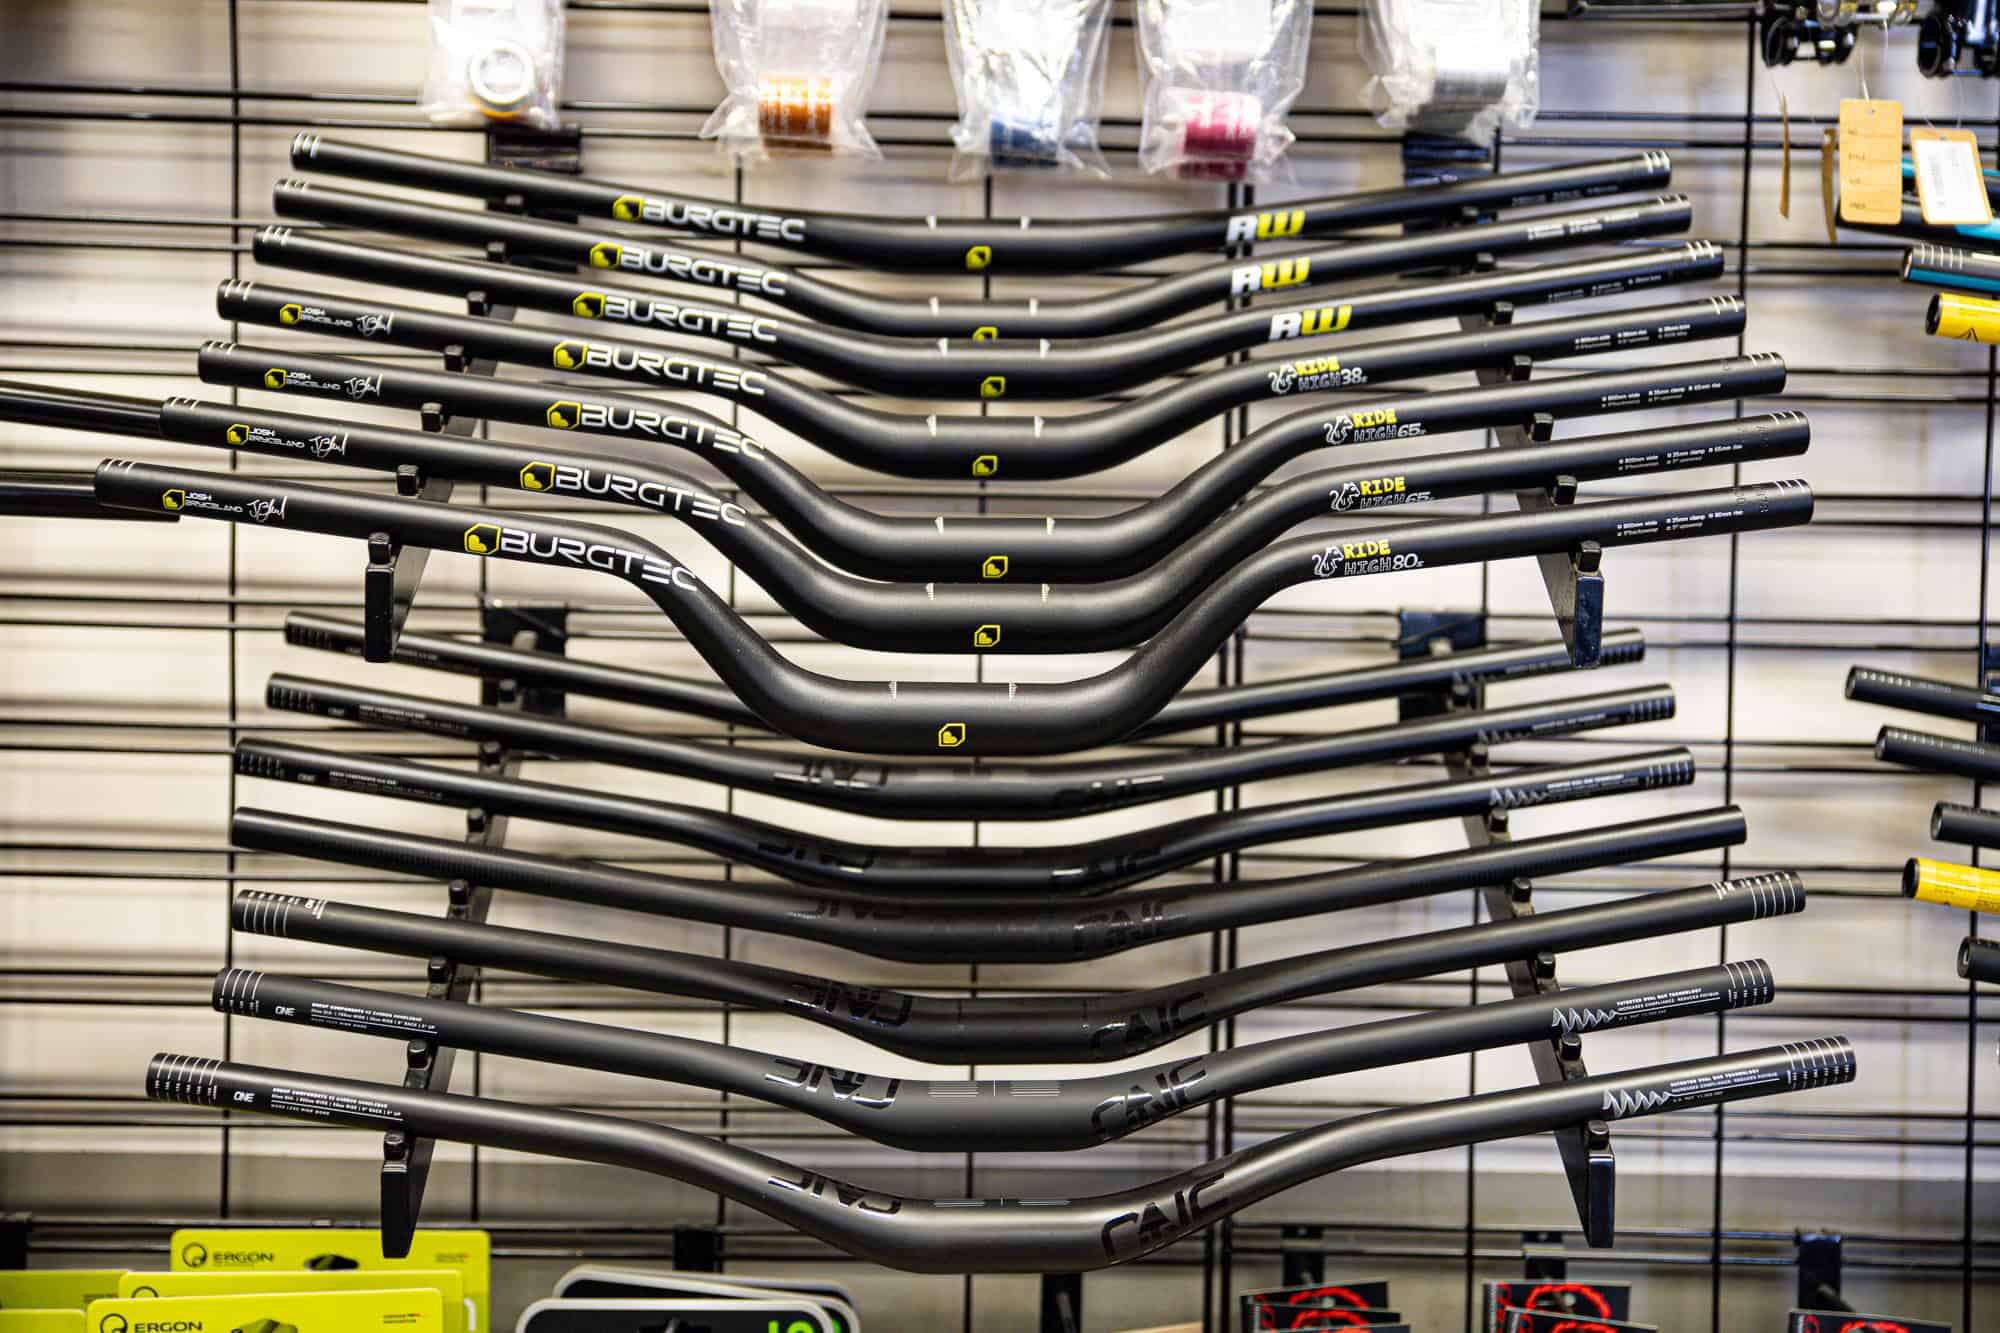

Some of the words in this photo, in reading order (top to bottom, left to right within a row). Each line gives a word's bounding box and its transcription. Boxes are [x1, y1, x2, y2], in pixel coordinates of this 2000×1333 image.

[643, 199, 806, 242] BURGTEC
[620, 246, 788, 296] BURGTEC
[604, 296, 779, 342] BURGTEC
[286, 371, 312, 380] JOSH
[586, 344, 767, 396] BURGTEC
[1295, 356, 1340, 375] RIDE
[1352, 408, 1398, 428] RIDE
[250, 427, 276, 437] JOSH
[581, 403, 767, 461] BURGTEC
[1354, 425, 1397, 442] HIGH
[1360, 476, 1406, 496] RIDE
[185, 491, 213, 502] JOSH
[555, 466, 747, 528] BURGTEC
[1342, 539, 1392, 560] RIDE
[501, 528, 699, 592] BURGTEC
[1344, 556, 1392, 577] HIGH
[233, 1091, 255, 1103] ONE
[212, 1251, 275, 1265] ERGON
[134, 1320, 203, 1333] ERGON
